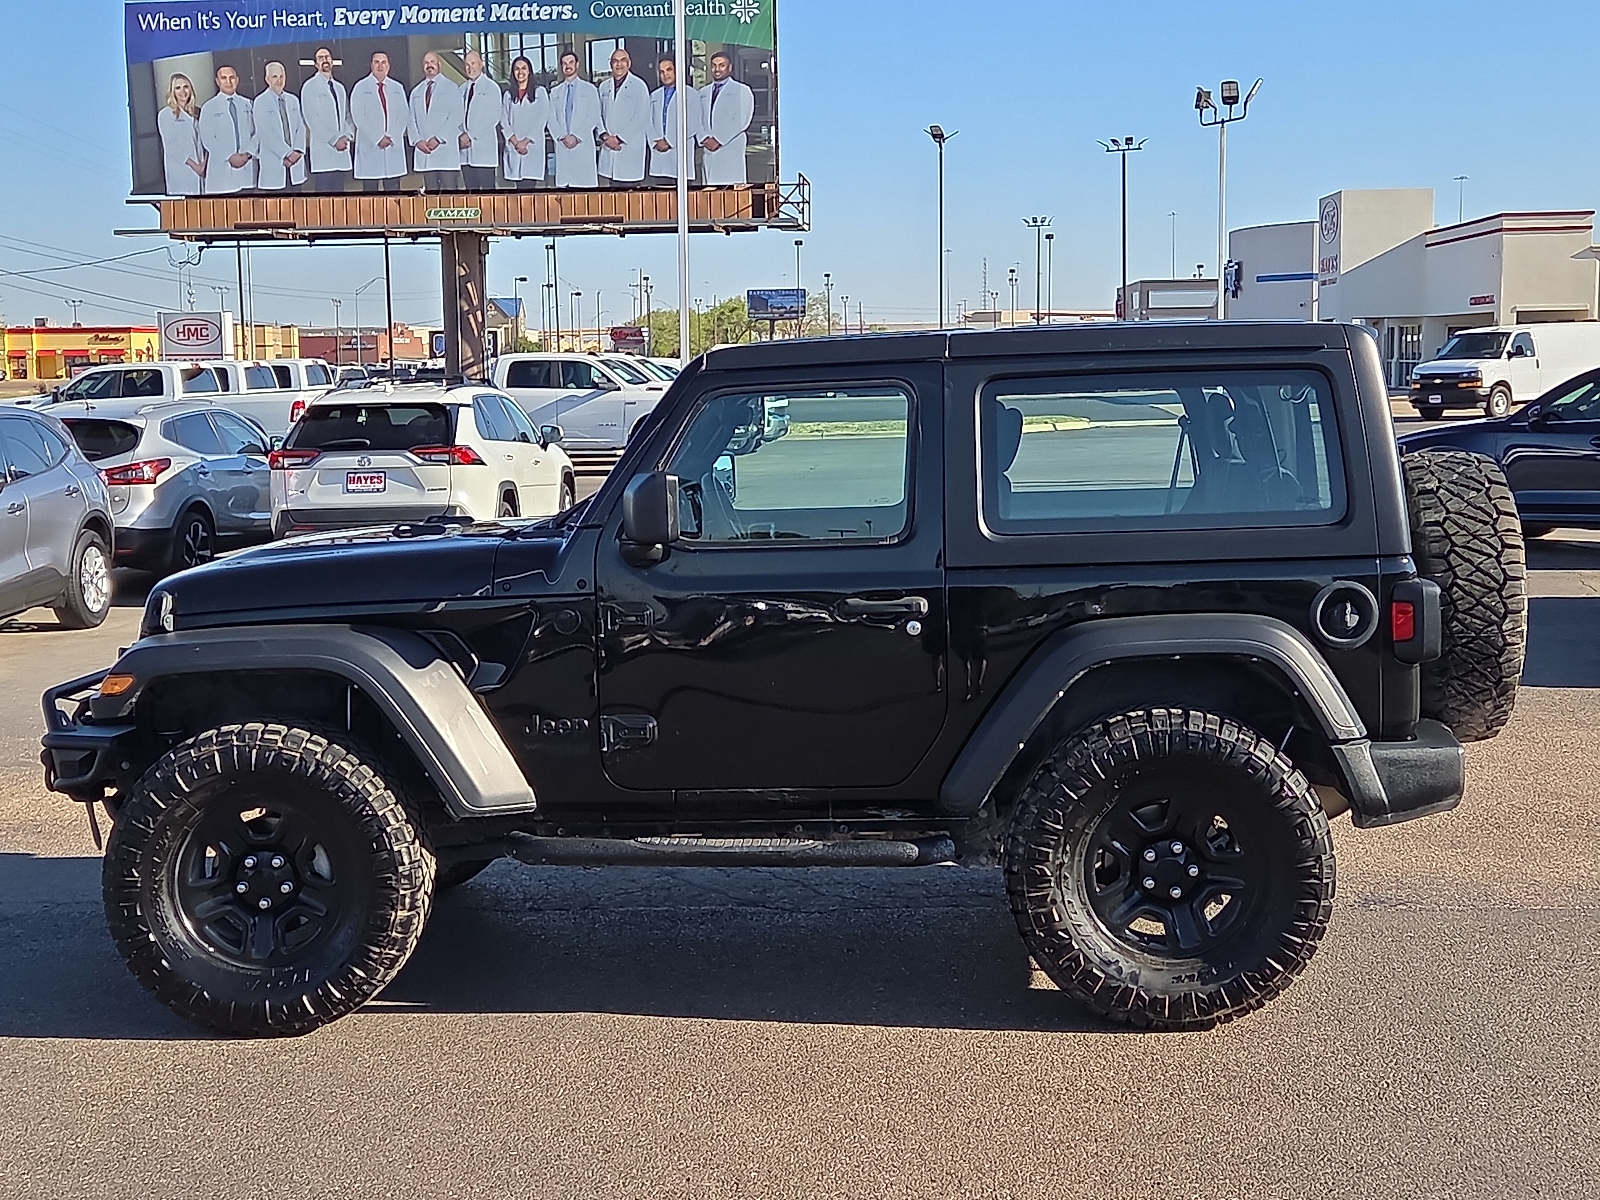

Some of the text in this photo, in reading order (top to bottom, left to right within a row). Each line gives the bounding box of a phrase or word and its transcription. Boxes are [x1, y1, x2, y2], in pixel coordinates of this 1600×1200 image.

[137, 2, 579, 31] When It's Your Heart, Every Moment Matters.
[431, 209, 475, 218] LAMAR
[176, 323, 210, 341] HMC
[348, 475, 383, 485] HAYES
[522, 714, 589, 738] Jeep
